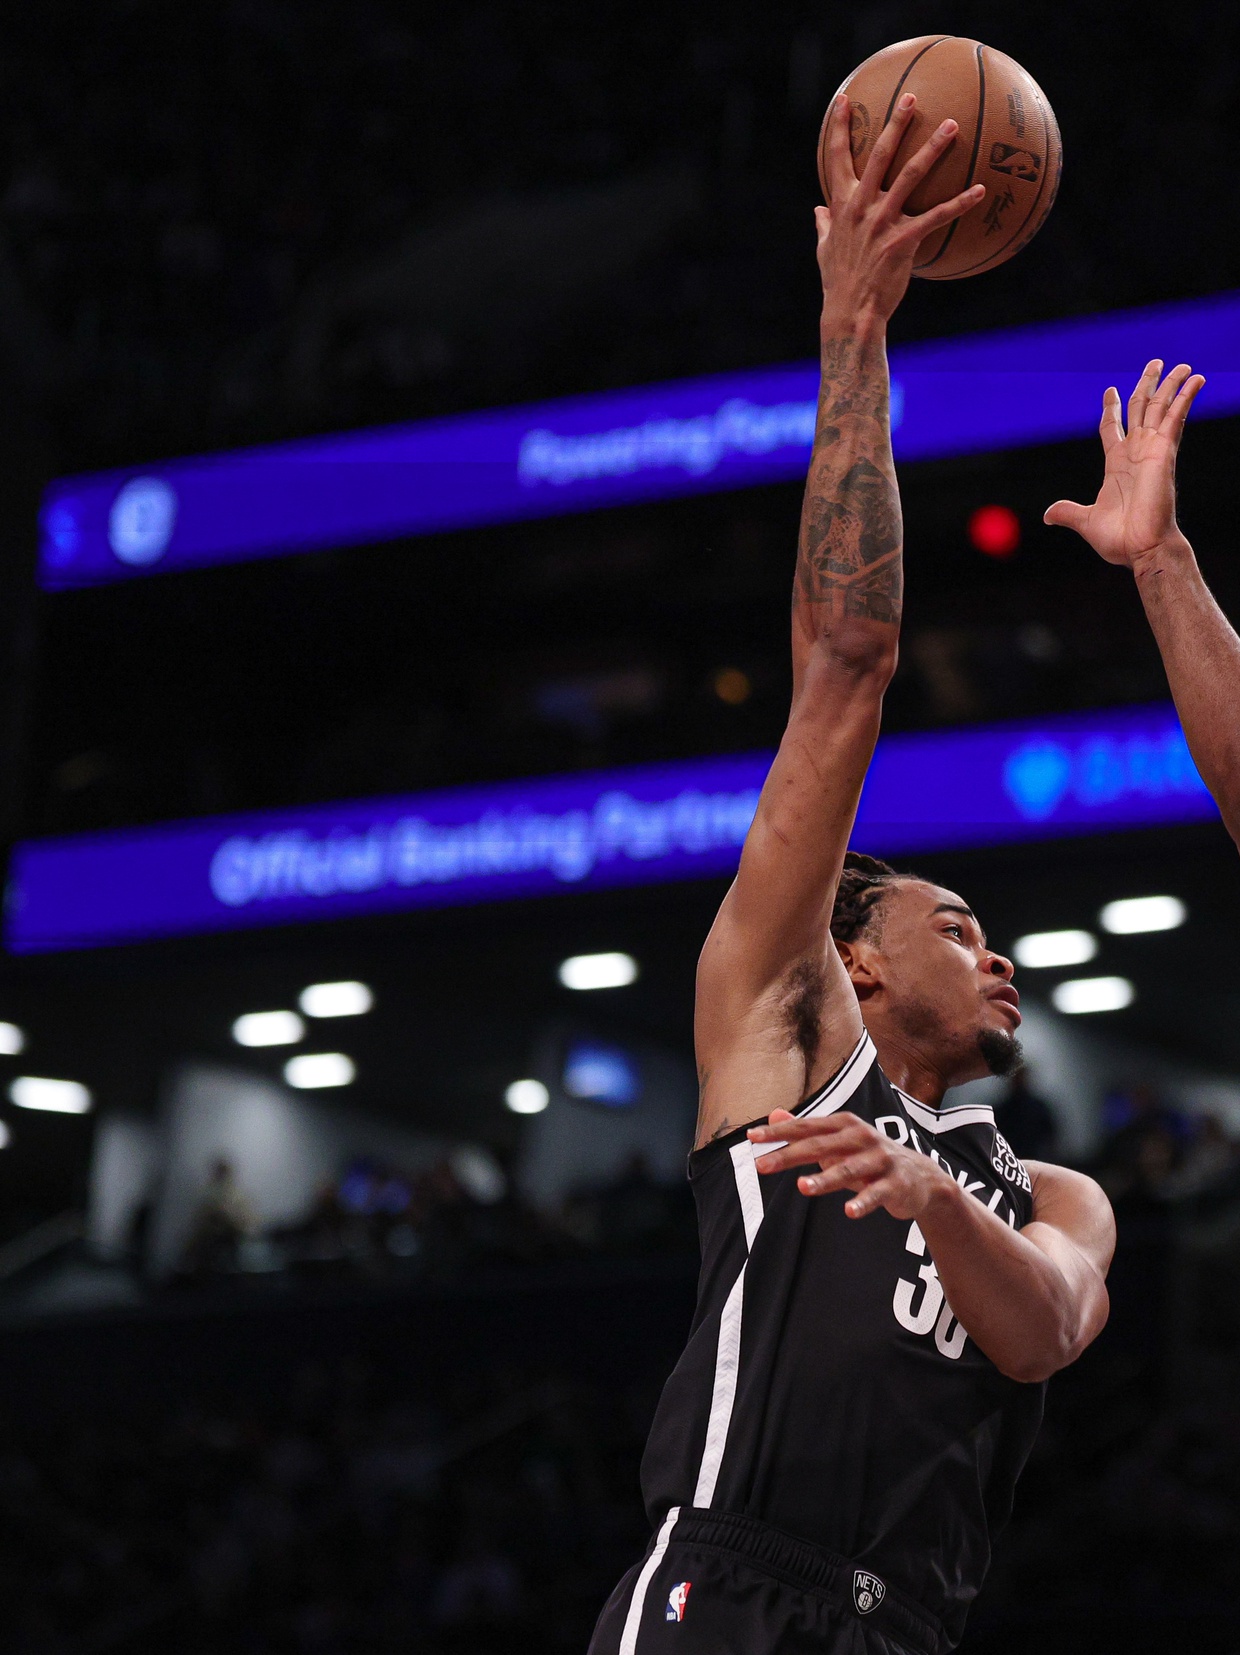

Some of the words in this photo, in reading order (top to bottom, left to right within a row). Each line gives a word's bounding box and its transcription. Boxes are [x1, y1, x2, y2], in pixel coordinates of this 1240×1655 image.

[521, 416, 713, 486] Powering
[211, 822, 383, 904] Official
[393, 808, 592, 884] Banking
[597, 791, 758, 859] Partne
[993, 1157, 1032, 1193] GUID
[995, 1142, 1030, 1180] YOU
[856, 1574, 883, 1599] NETS
